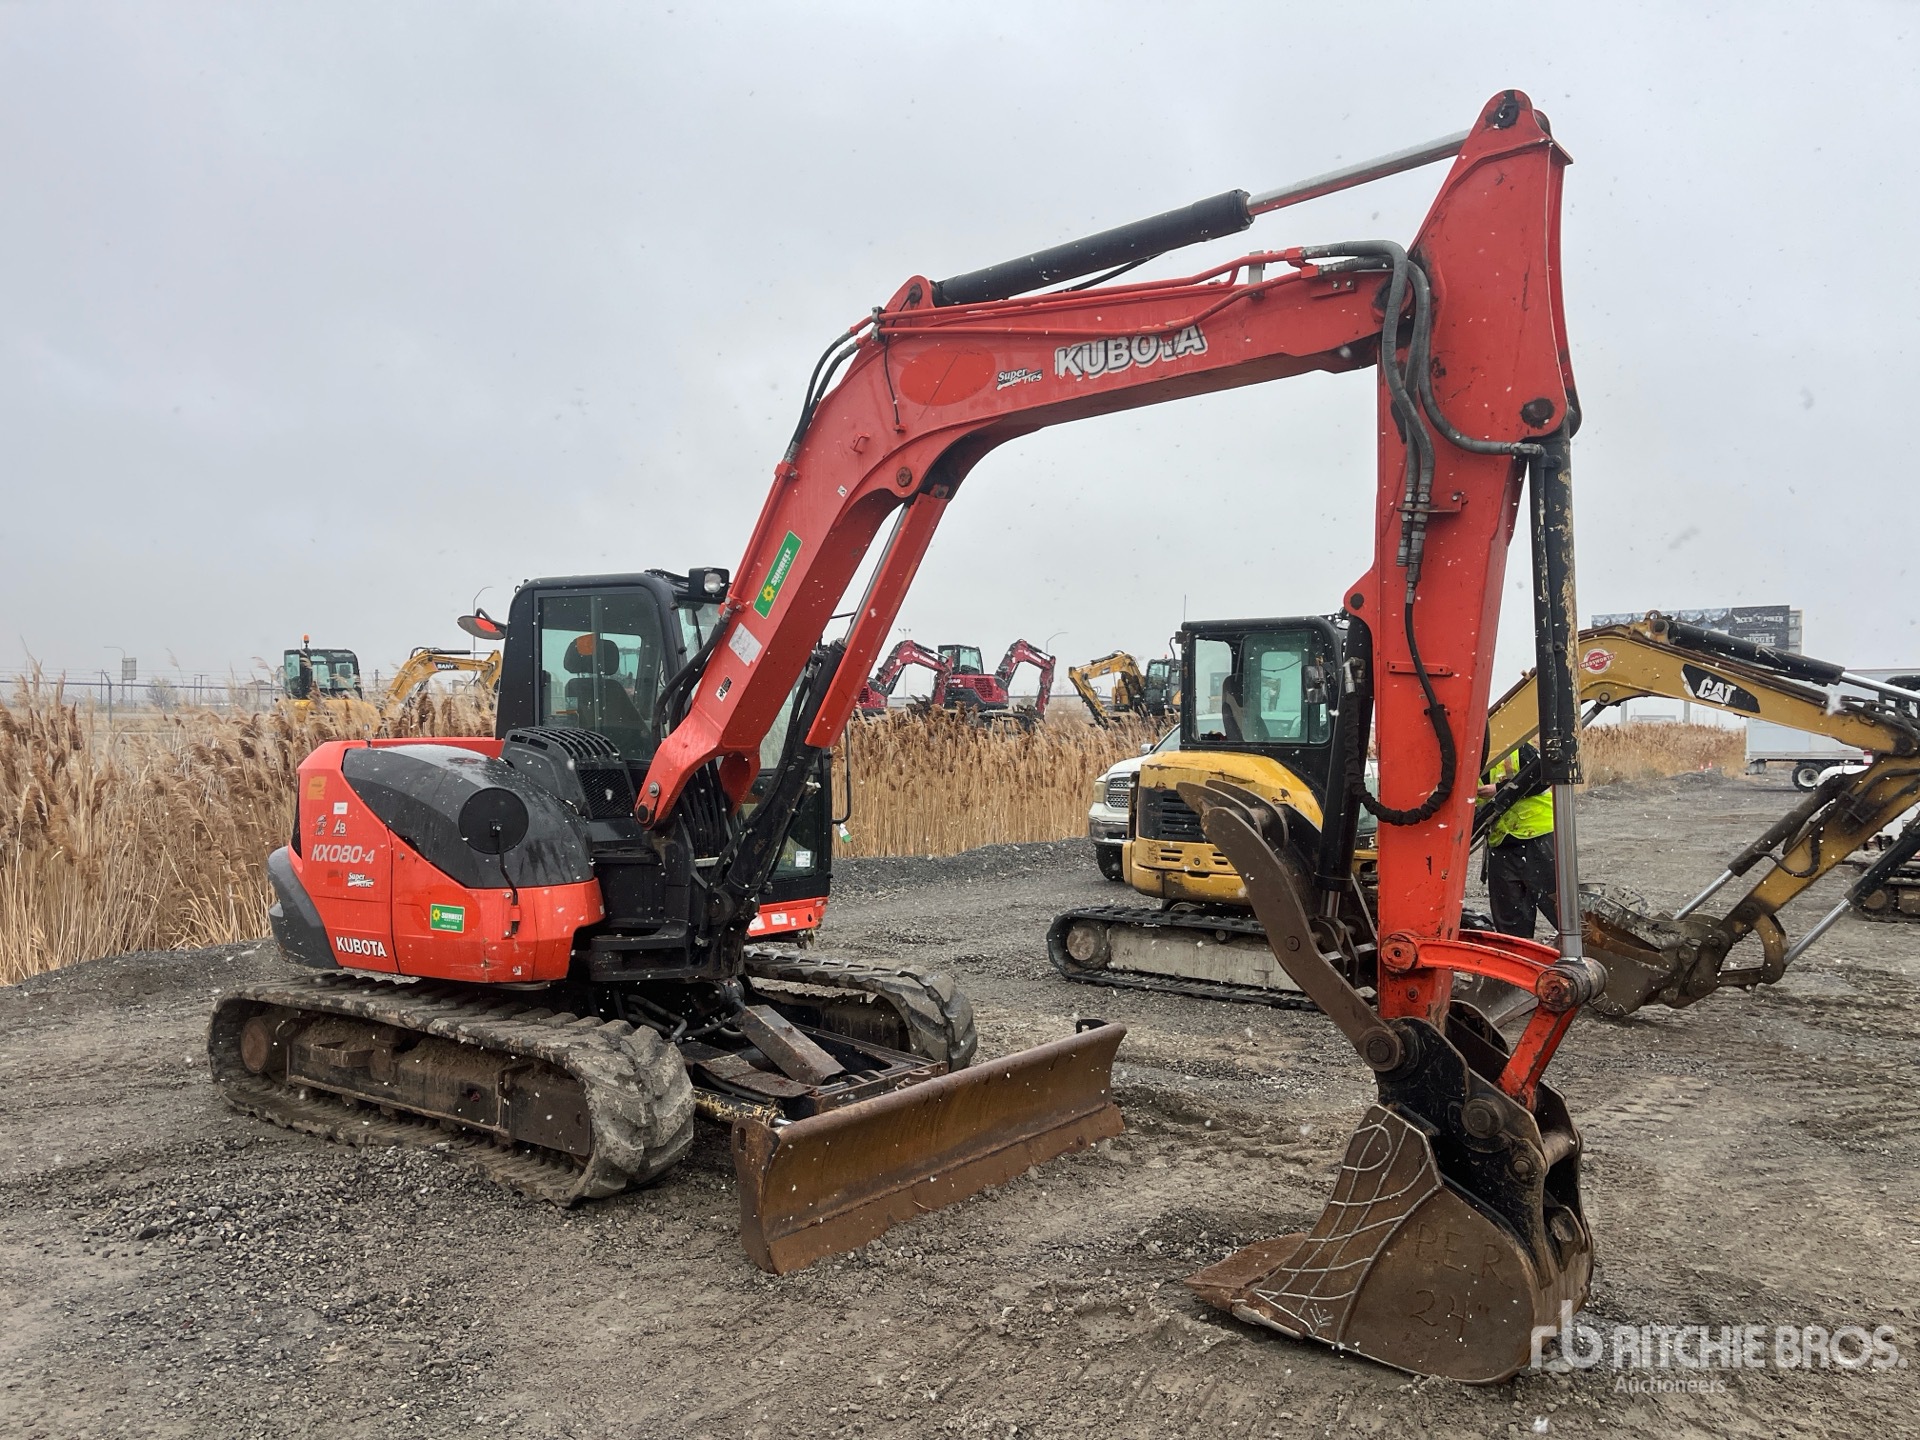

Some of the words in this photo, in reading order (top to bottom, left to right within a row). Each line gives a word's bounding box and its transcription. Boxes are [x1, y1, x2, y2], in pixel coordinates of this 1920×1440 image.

[998, 368, 1028, 382] Super
[1696, 677, 1737, 704] CAT
[311, 844, 375, 864] KX080-4
[336, 936, 388, 957] KUBOTA
